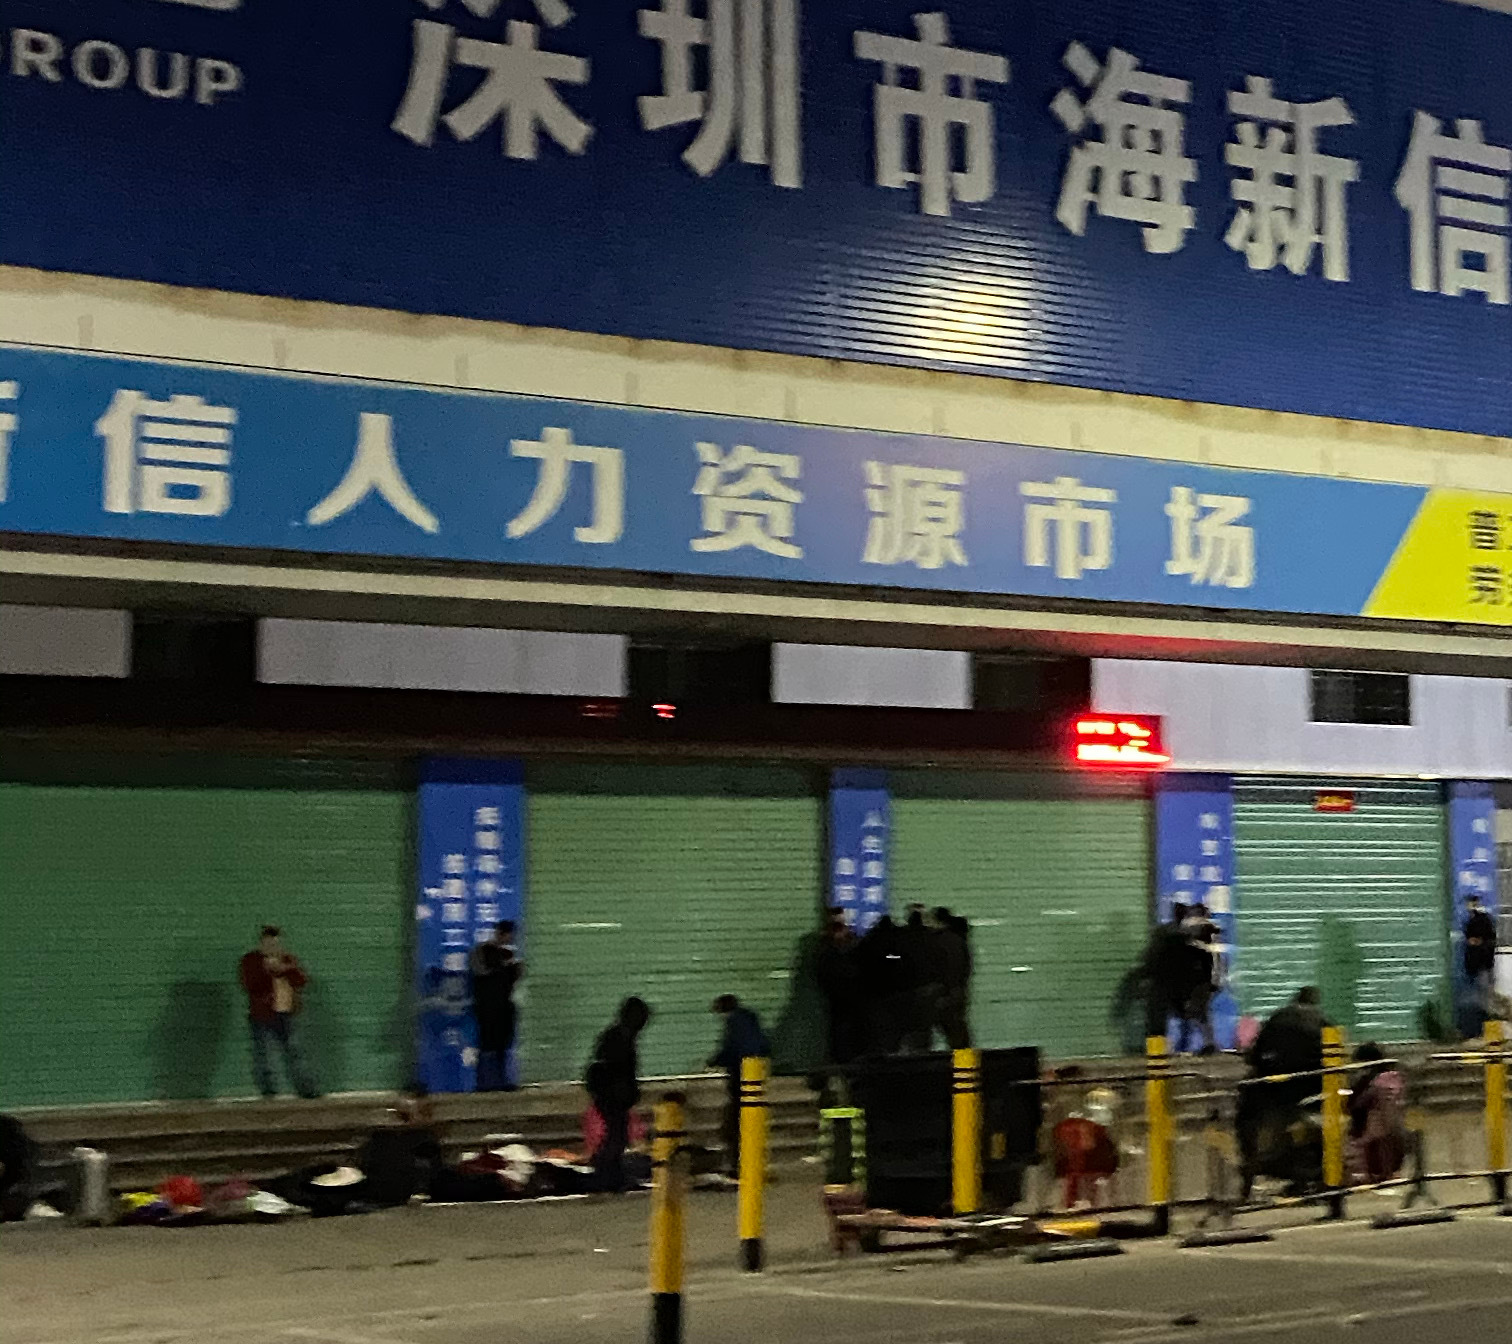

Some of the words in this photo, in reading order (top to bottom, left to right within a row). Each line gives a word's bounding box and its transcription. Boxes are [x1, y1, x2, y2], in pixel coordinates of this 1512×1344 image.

[9, 27, 244, 105] ROUP
[0, 381, 1257, 589] 信人力资源市场
